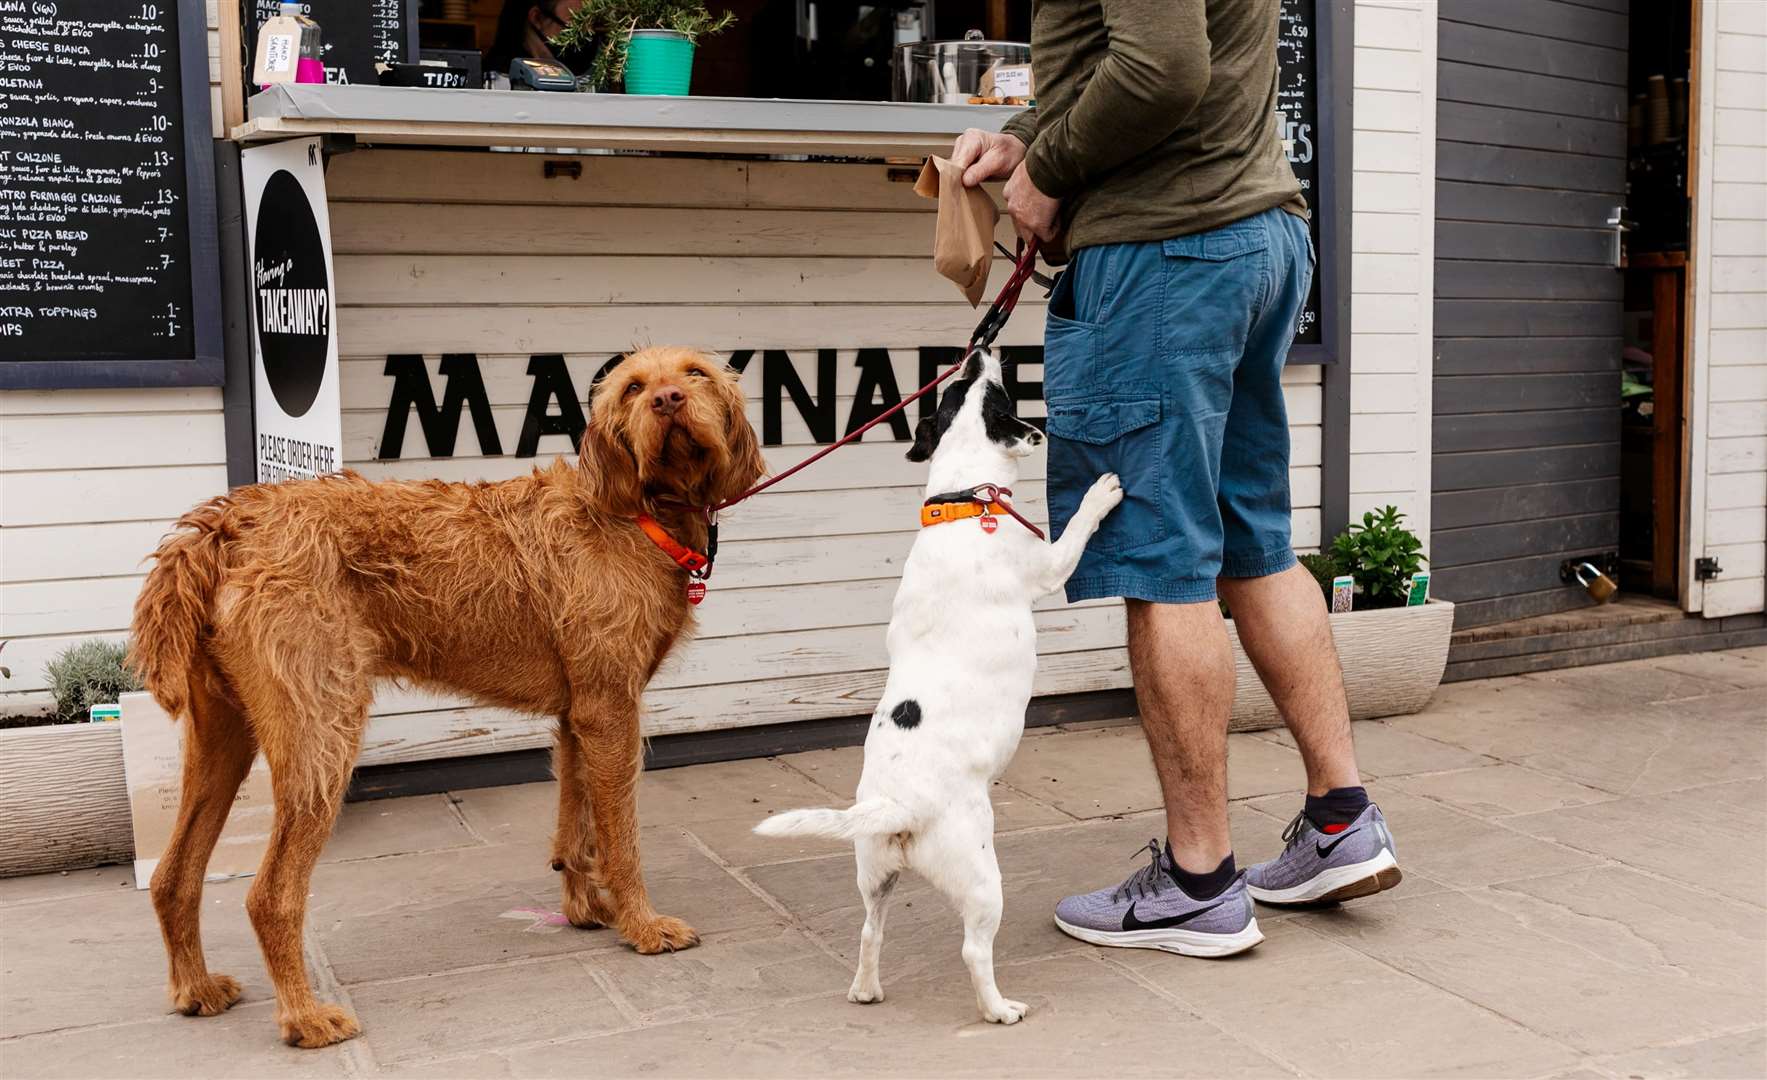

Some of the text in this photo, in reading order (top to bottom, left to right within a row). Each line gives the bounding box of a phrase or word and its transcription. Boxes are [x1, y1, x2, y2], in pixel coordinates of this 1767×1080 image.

[11, 39, 50, 51] CHEESE
[53, 43, 91, 55] BIANCA
[42, 117, 75, 129] BIANCA
[15, 151, 63, 164] CALZONE
[30, 190, 77, 204] FORMAGGI
[81, 192, 123, 205] CALZONE
[22, 228, 53, 240] PIZZA
[55, 229, 89, 241] BREAD
[32, 258, 65, 271] PIZZA
[255, 257, 293, 289] Having a
[38, 306, 98, 320] TOPPINGS
[259, 288, 328, 336] TAKEAWAY?
[378, 345, 1046, 459] MANAE
[260, 433, 335, 474] PLEASE ORDER HERE
